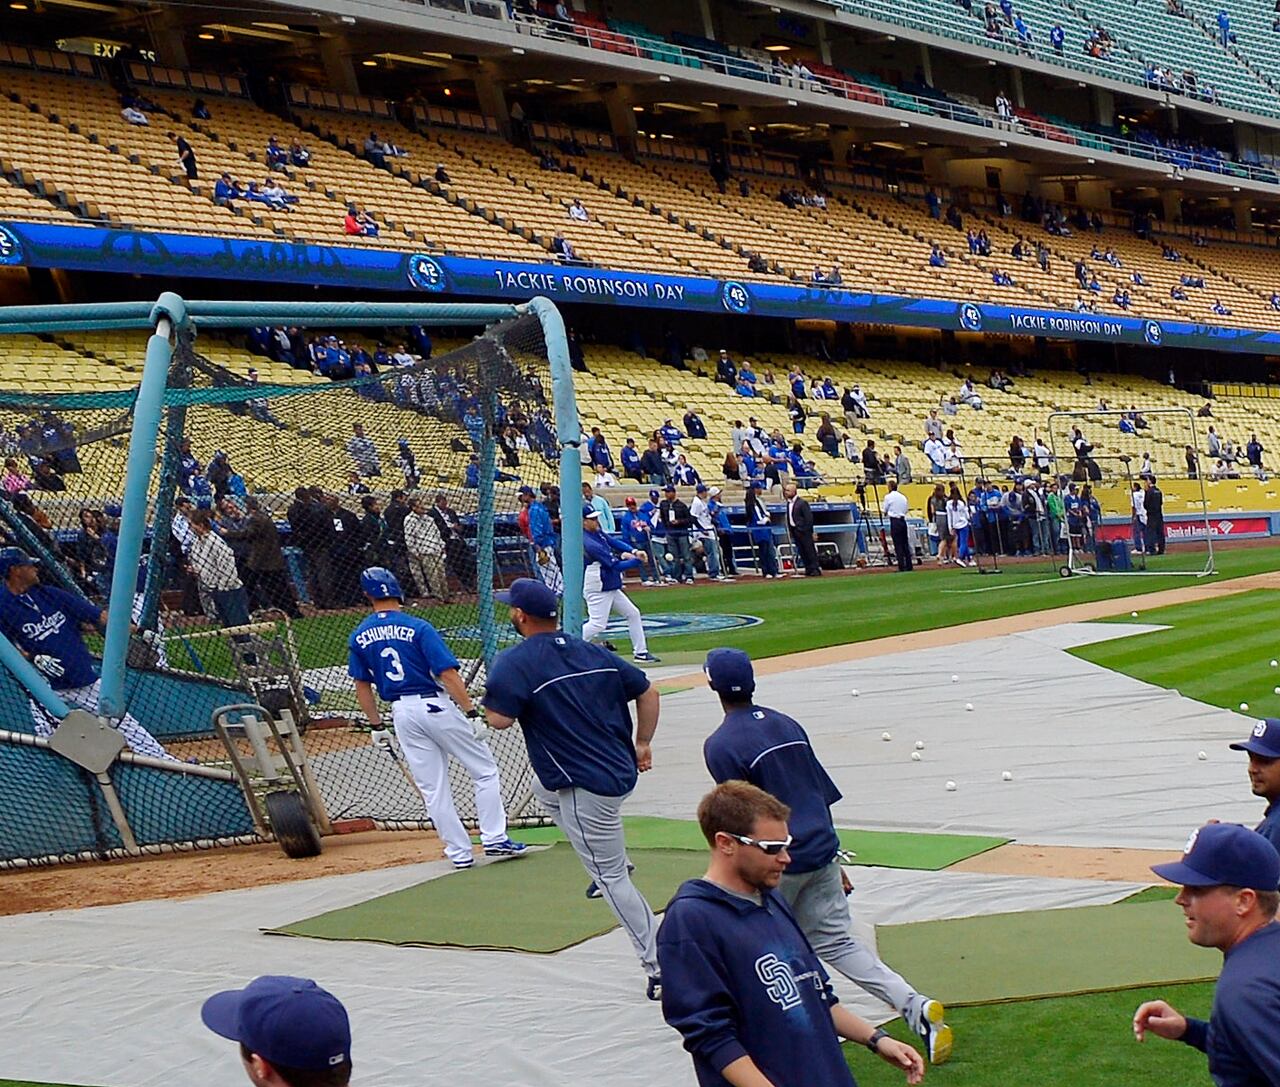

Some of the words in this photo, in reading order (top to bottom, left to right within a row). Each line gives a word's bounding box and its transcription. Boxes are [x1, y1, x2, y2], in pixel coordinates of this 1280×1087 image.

[496, 270, 555, 290] JACKIE
[563, 274, 649, 297] ROBINSON
[655, 283, 685, 300] DAY
[1010, 314, 1047, 330] JACKIE
[1050, 317, 1101, 335] ROBINSON
[1103, 323, 1124, 336] DAY
[380, 584, 388, 592] 3
[356, 625, 415, 649] SCHUMAKER
[380, 647, 405, 681] 3
